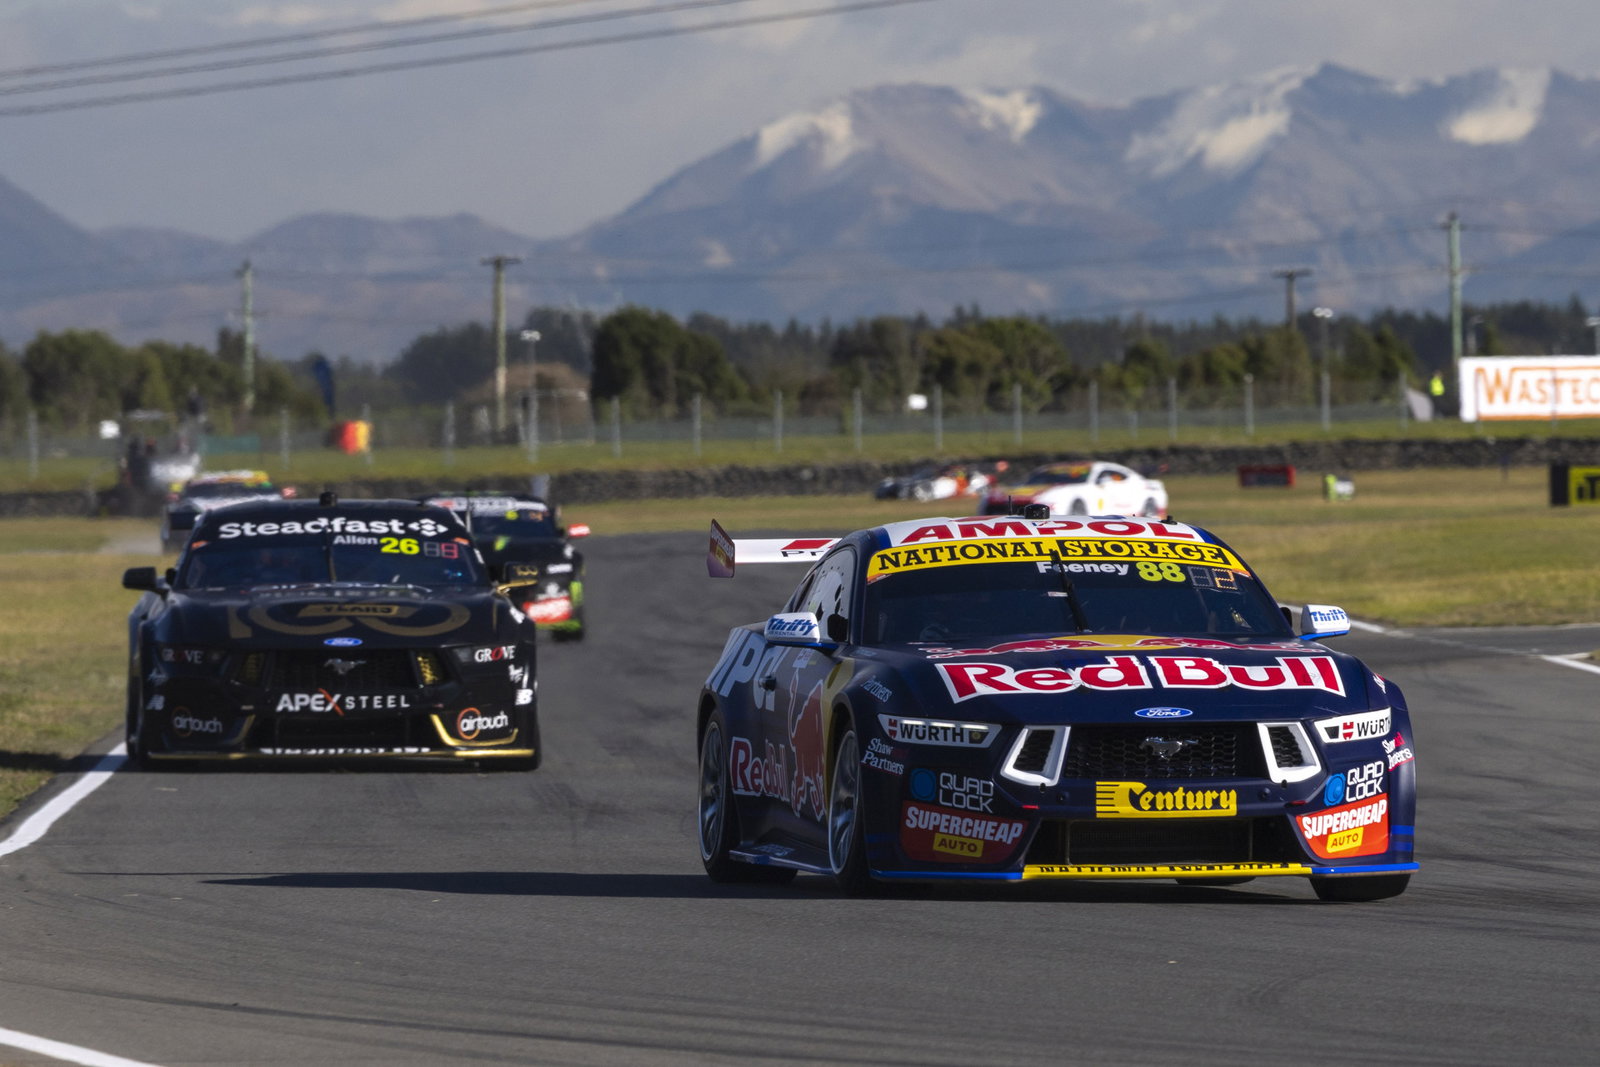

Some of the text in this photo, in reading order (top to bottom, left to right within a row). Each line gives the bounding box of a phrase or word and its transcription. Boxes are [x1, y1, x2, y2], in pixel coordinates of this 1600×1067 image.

[219, 517, 405, 539] Steadfast
[900, 520, 1194, 544] AMPOL
[333, 535, 378, 545] Allen
[380, 537, 420, 555] 26
[878, 540, 1223, 571] NATIONAL STORAGE
[1036, 561, 1129, 576] Feeney
[1136, 561, 1186, 583] 88
[768, 618, 818, 636] Thrifty
[475, 645, 516, 662] GROVE
[936, 656, 1153, 704] Red
[1147, 656, 1346, 697] Bull
[276, 688, 410, 716] APEX STEEL
[461, 710, 509, 731] airtouch
[900, 724, 964, 742] WÜRTH
[868, 738, 893, 756] Shaw
[861, 750, 904, 775] Partners
[1347, 761, 1384, 785] QUAD
[940, 772, 994, 796] QUAD
[1346, 777, 1383, 802] LOCK
[939, 789, 993, 814] LOCK
[1096, 781, 1237, 818] Century
[905, 806, 1023, 845] SUPERCHEAP
[1302, 799, 1388, 839] SUPERCHEAP
[938, 838, 978, 853] AUTO
[1330, 833, 1359, 849] AUTO
